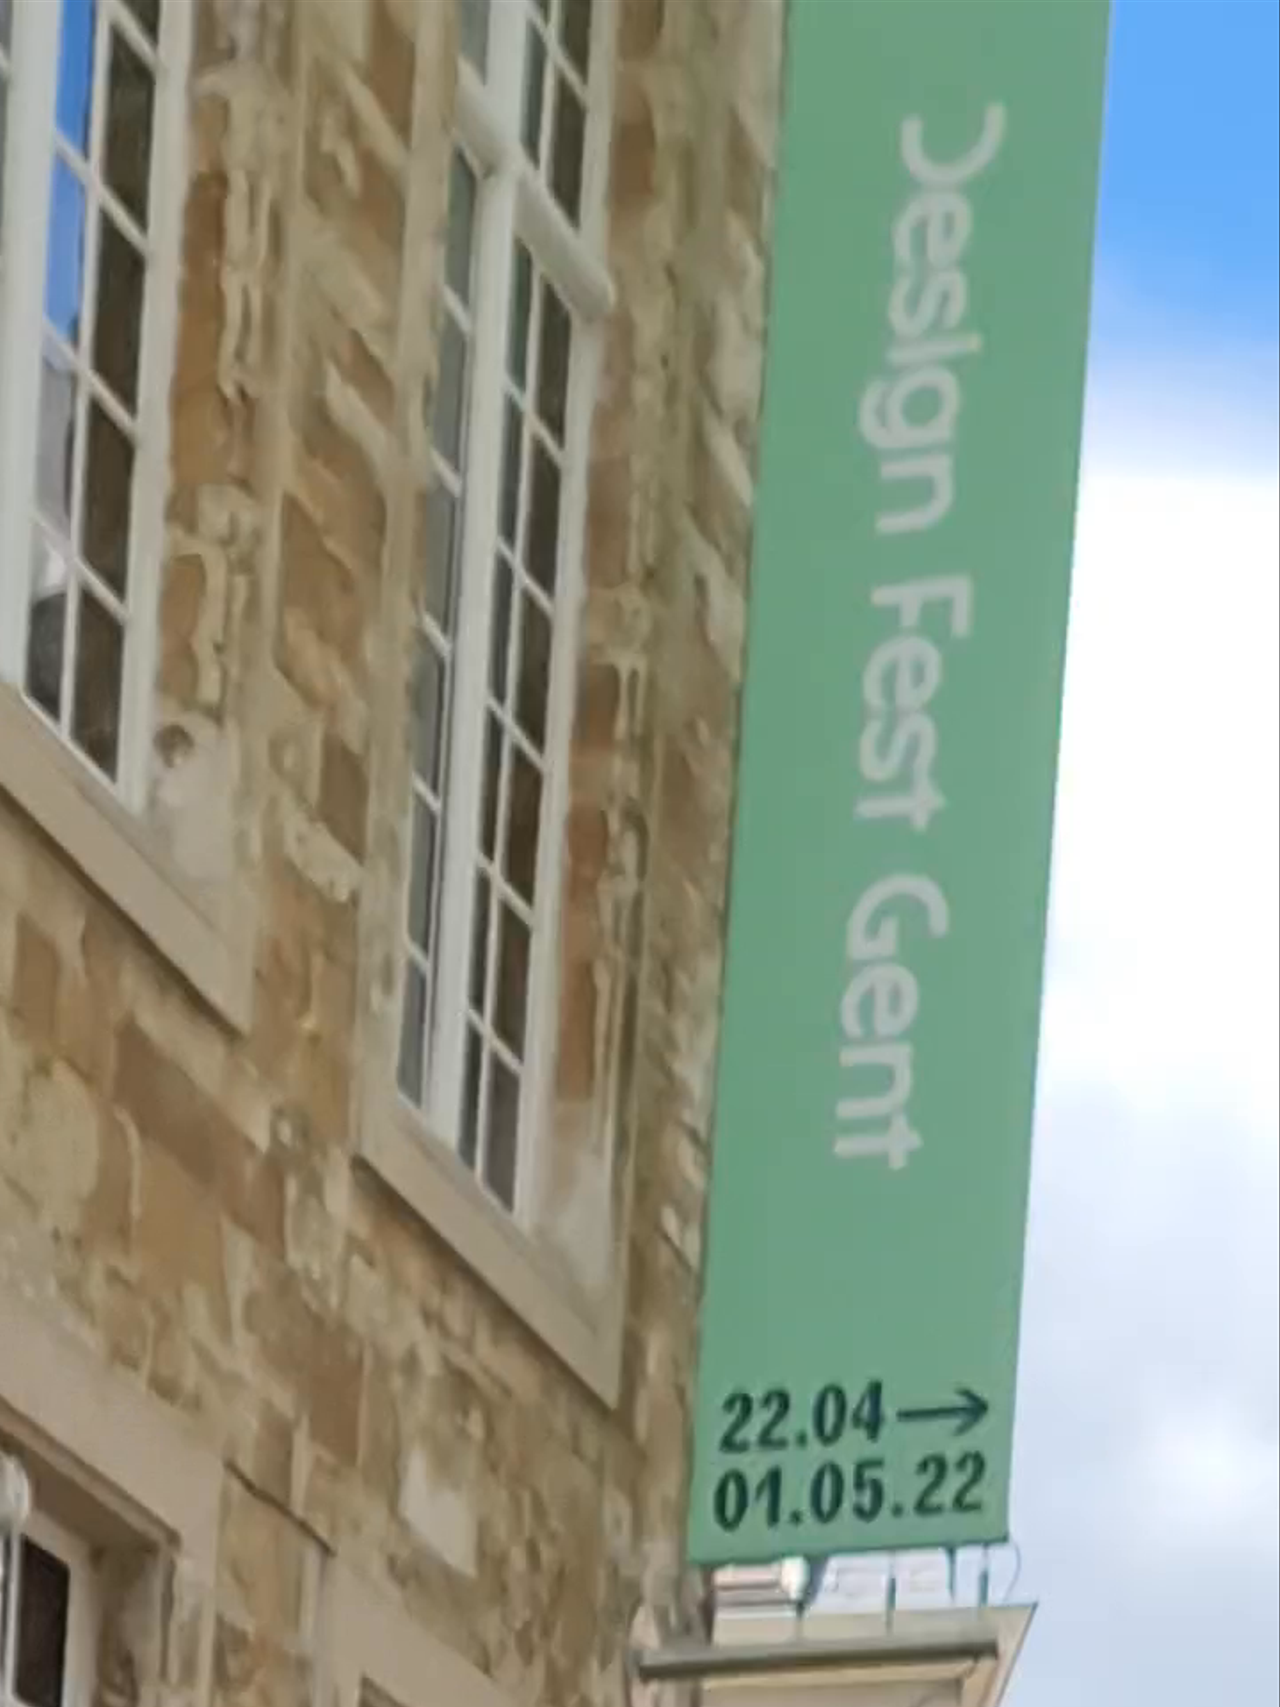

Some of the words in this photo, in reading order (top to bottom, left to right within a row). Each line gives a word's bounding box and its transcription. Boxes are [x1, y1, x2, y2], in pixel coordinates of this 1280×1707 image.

[858, 103, 1003, 533] Design
[854, 577, 973, 830] Fest
[830, 875, 950, 1170] Gent
[712, 1449, 987, 1533] 01.05.22
[716, 1378, 886, 1455] 22.04
